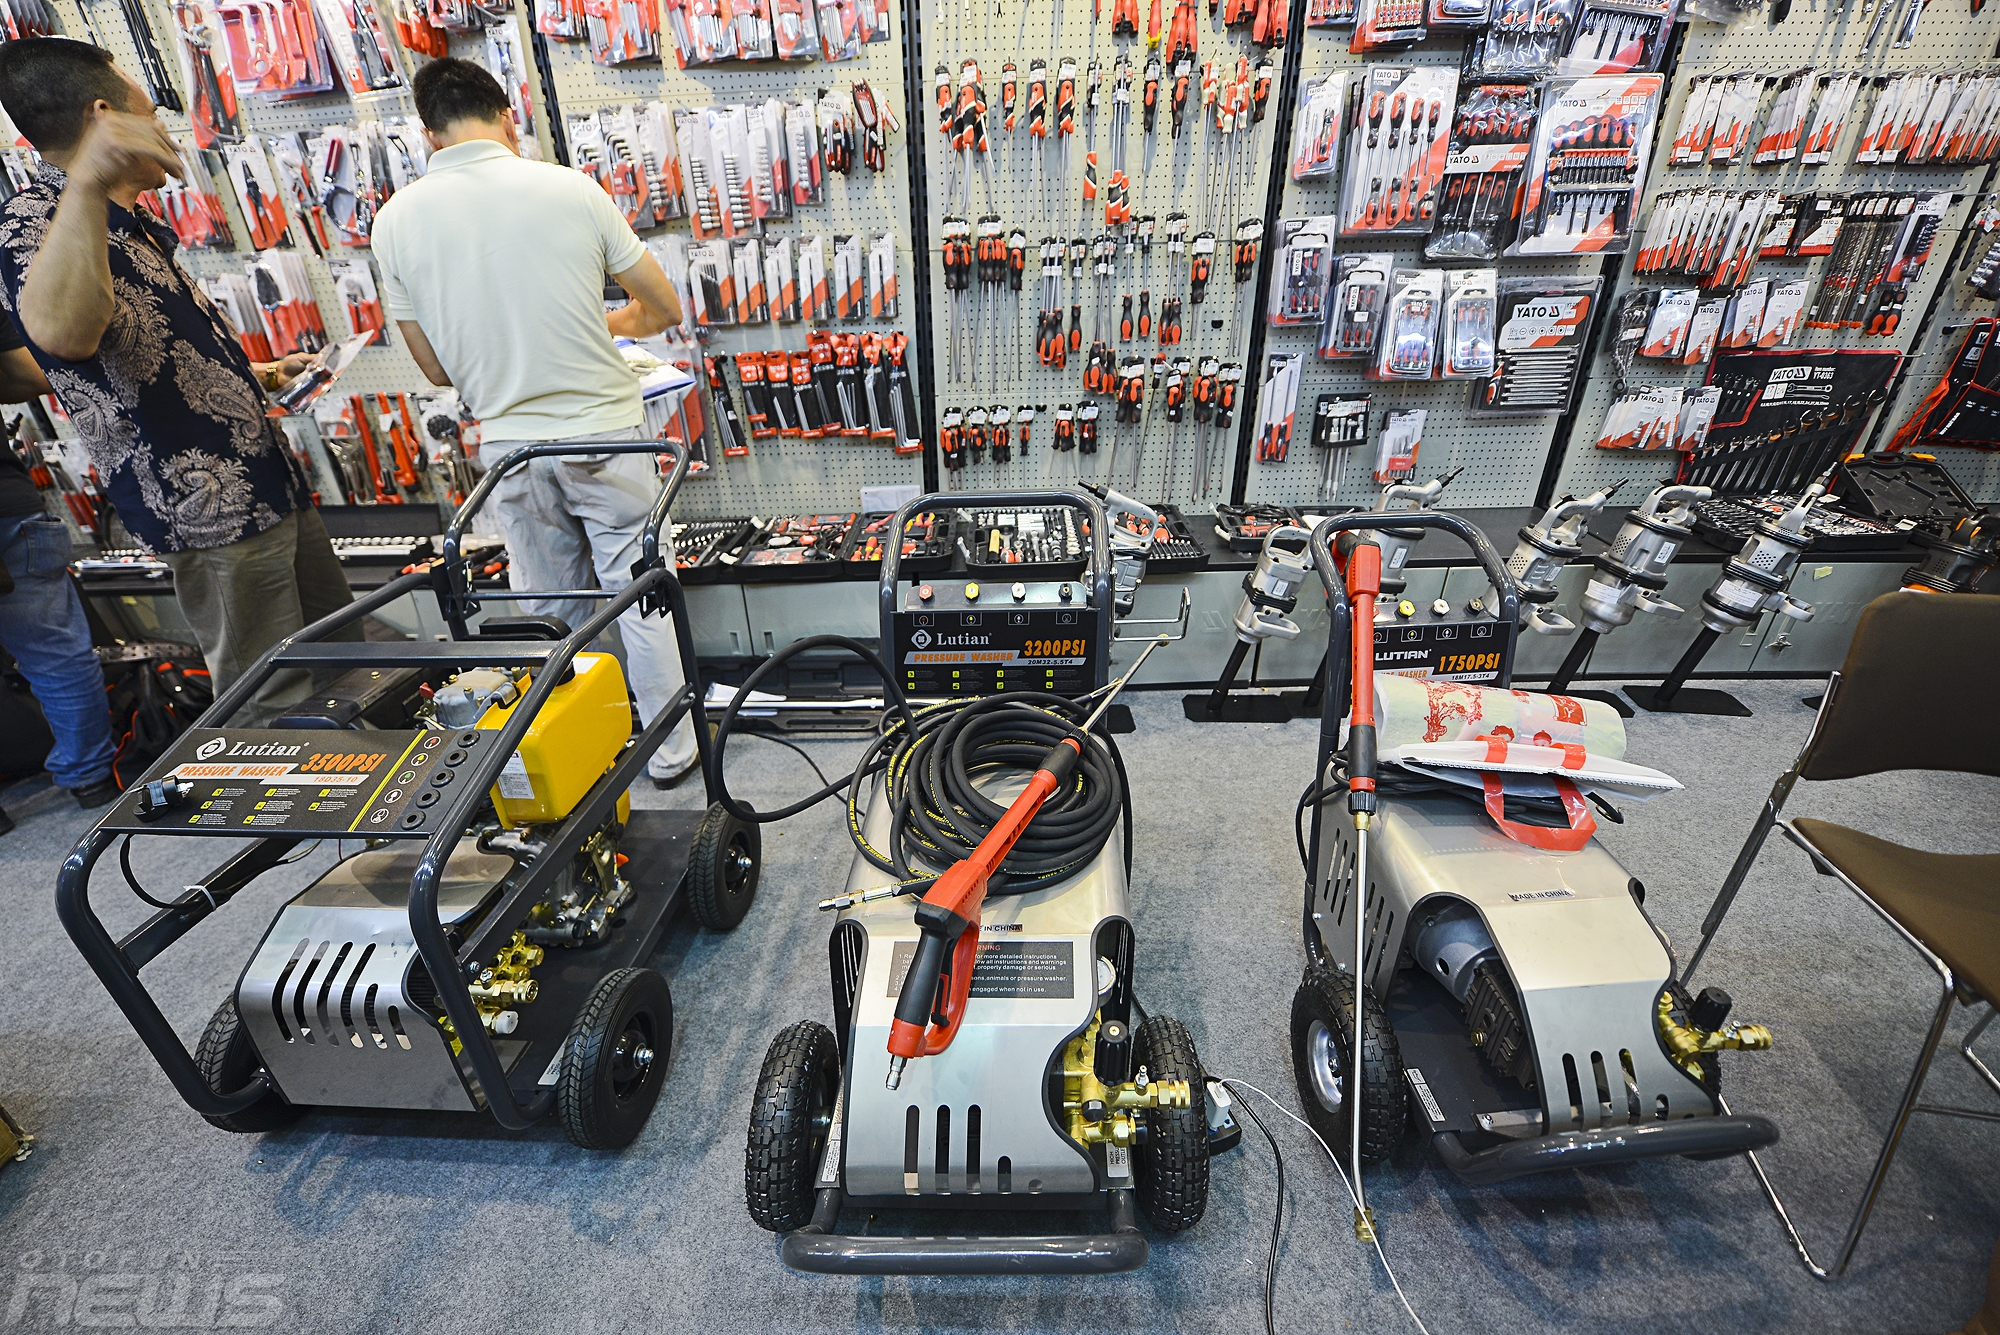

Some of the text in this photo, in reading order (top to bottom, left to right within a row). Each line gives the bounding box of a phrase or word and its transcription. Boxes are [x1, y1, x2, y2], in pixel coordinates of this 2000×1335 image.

[1375, 71, 1393, 79] YATO
[820, 101, 835, 109] YATO
[1557, 100, 1579, 108] YATO
[1449, 154, 1471, 164] YATO
[1664, 298, 1683, 306] YATO
[1516, 306, 1547, 318] YATO
[1772, 369, 1794, 380] YATO
[1640, 394, 1657, 402] YATO
[936, 632, 990, 646] Lutian
[1024, 639, 1087, 657] 3200PSI
[913, 652, 1014, 663] PRESSURE WASHER
[1375, 650, 1429, 662] LUTIAN
[1438, 652, 1501, 672] 1750PSI
[1399, 669, 1428, 679] WASHER
[226, 740, 301, 757] Lutian
[300, 752, 388, 773] 3500PSI
[175, 765, 290, 778] PRESSURE WASHER
[313, 775, 358, 783] 18D35-10
[1512, 891, 1536, 902] MADE
[1545, 889, 1572, 898] CHINA
